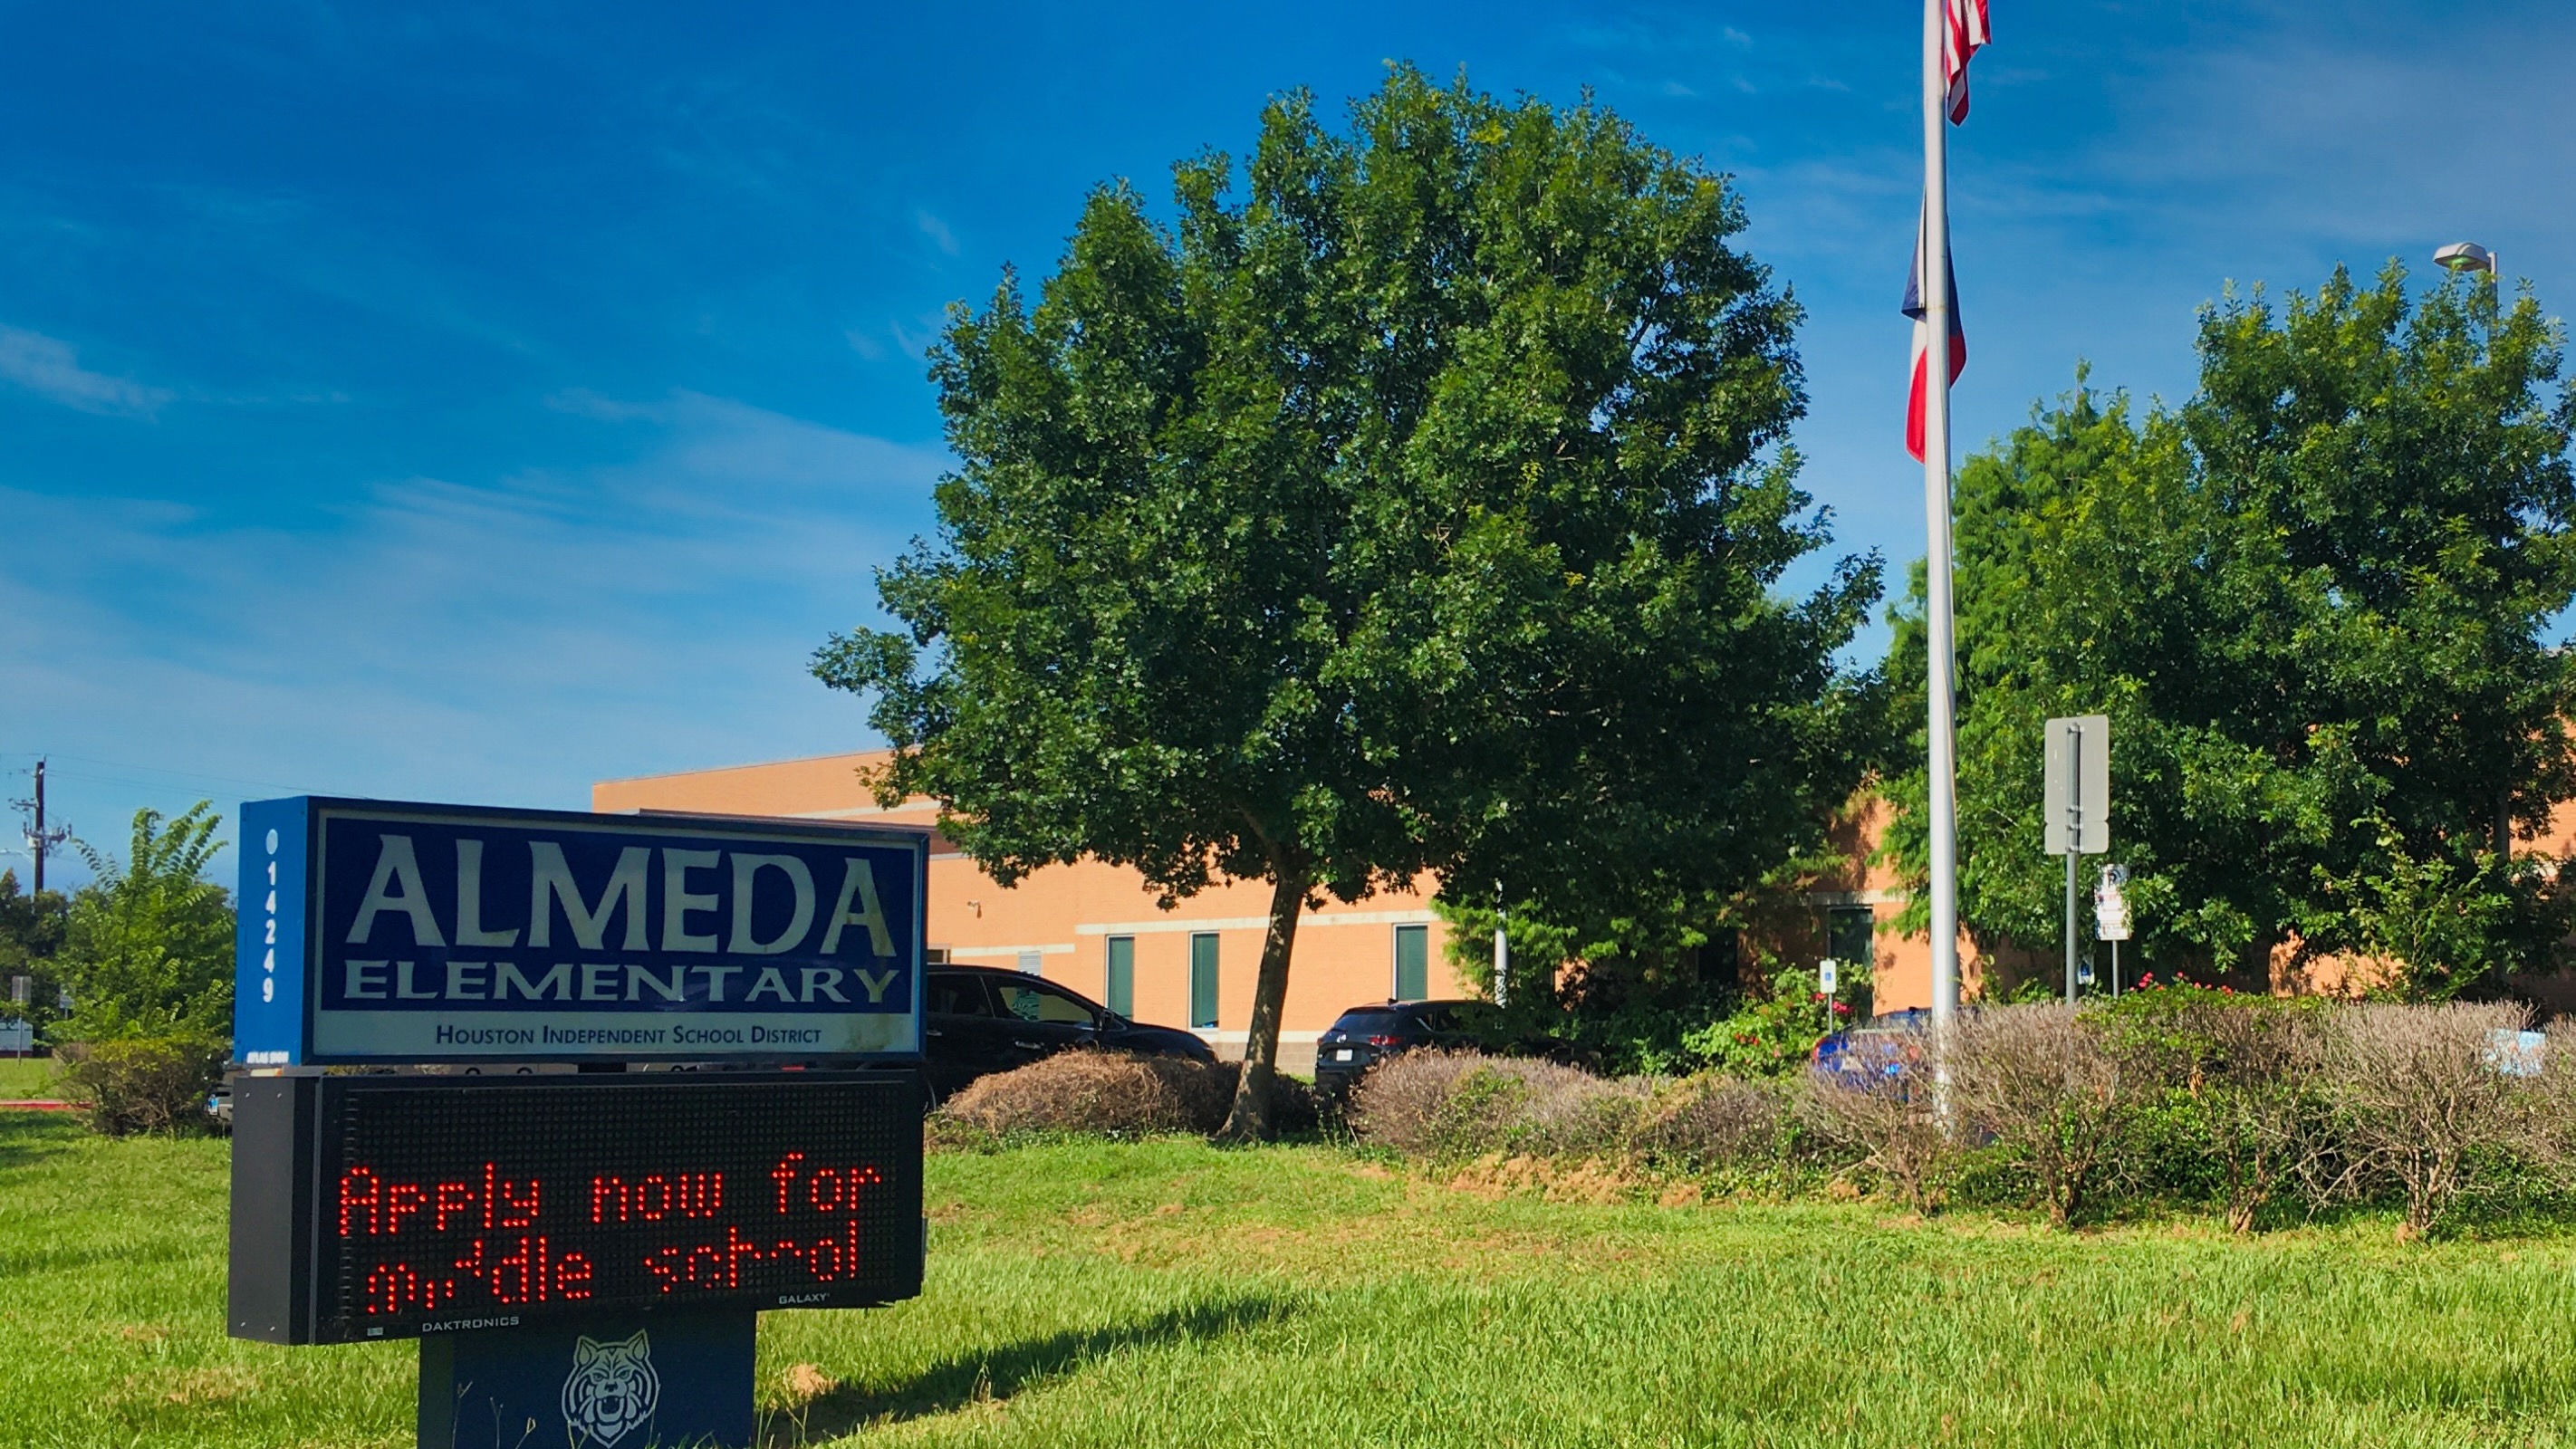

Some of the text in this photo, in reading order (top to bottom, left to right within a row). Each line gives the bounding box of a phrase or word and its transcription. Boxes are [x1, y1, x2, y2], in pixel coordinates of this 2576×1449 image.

[345, 834, 897, 957] ALMEDA
[263, 860, 277, 1003] 14249
[344, 960, 900, 1003] ELEMENTARY
[436, 1024, 822, 1045] HOUSTON INDEPENDENT SCHOOL DISTRICT
[339, 1151, 881, 1235] Apply now for
[778, 1291, 827, 1305] GALAXY
[421, 1316, 521, 1333] DAKTRONICS
